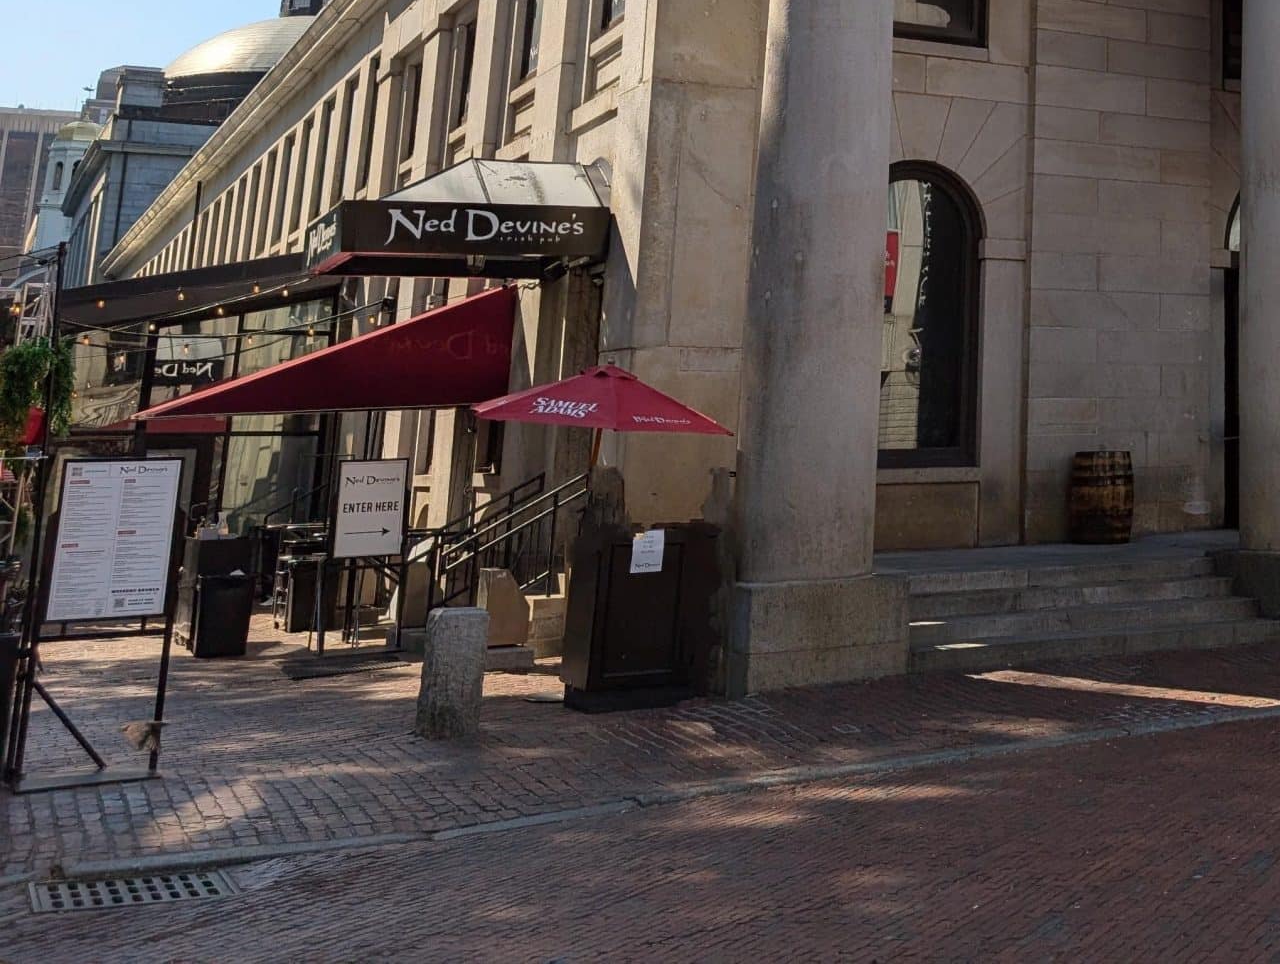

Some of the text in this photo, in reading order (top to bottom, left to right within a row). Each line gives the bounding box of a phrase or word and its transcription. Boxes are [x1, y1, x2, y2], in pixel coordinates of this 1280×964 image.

[384, 208, 457, 246] Ned
[529, 405, 588, 419] ADAMS
[533, 397, 599, 413] SAMUEL
[343, 501, 400, 514] ENTER HERE
